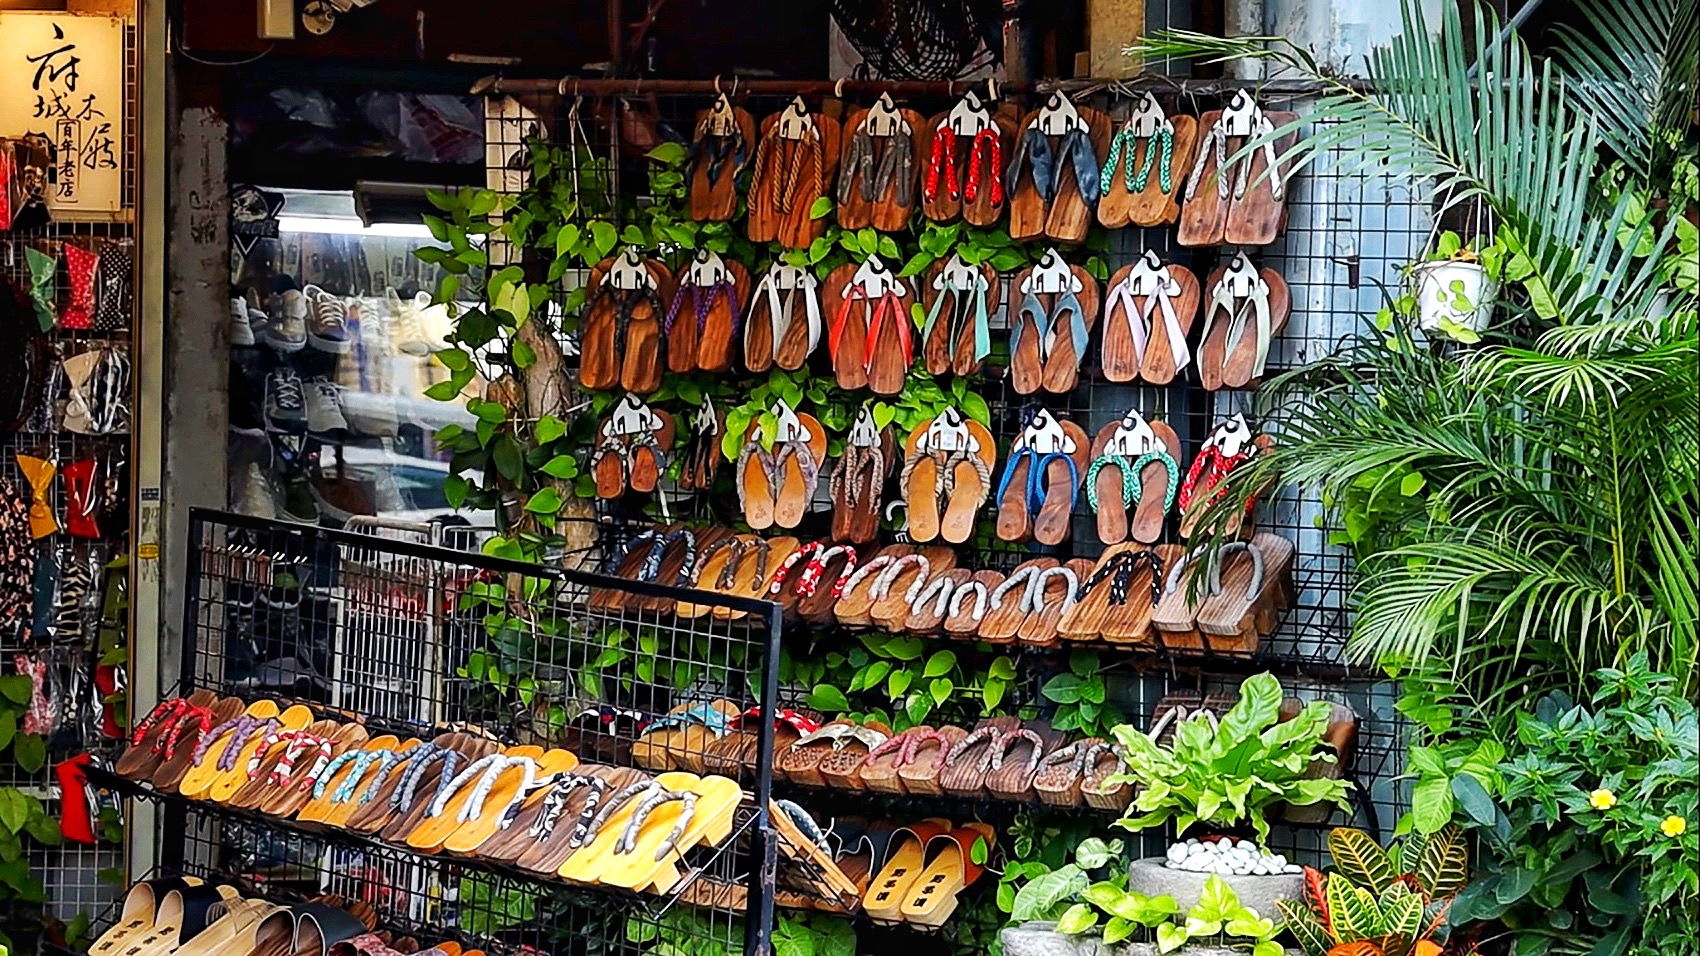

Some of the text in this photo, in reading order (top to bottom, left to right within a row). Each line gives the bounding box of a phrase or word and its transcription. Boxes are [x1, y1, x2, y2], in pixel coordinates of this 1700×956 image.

[26, 22, 81, 120] 府城
[57, 121, 78, 197] 百年老店
[76, 93, 118, 170] 木屐
